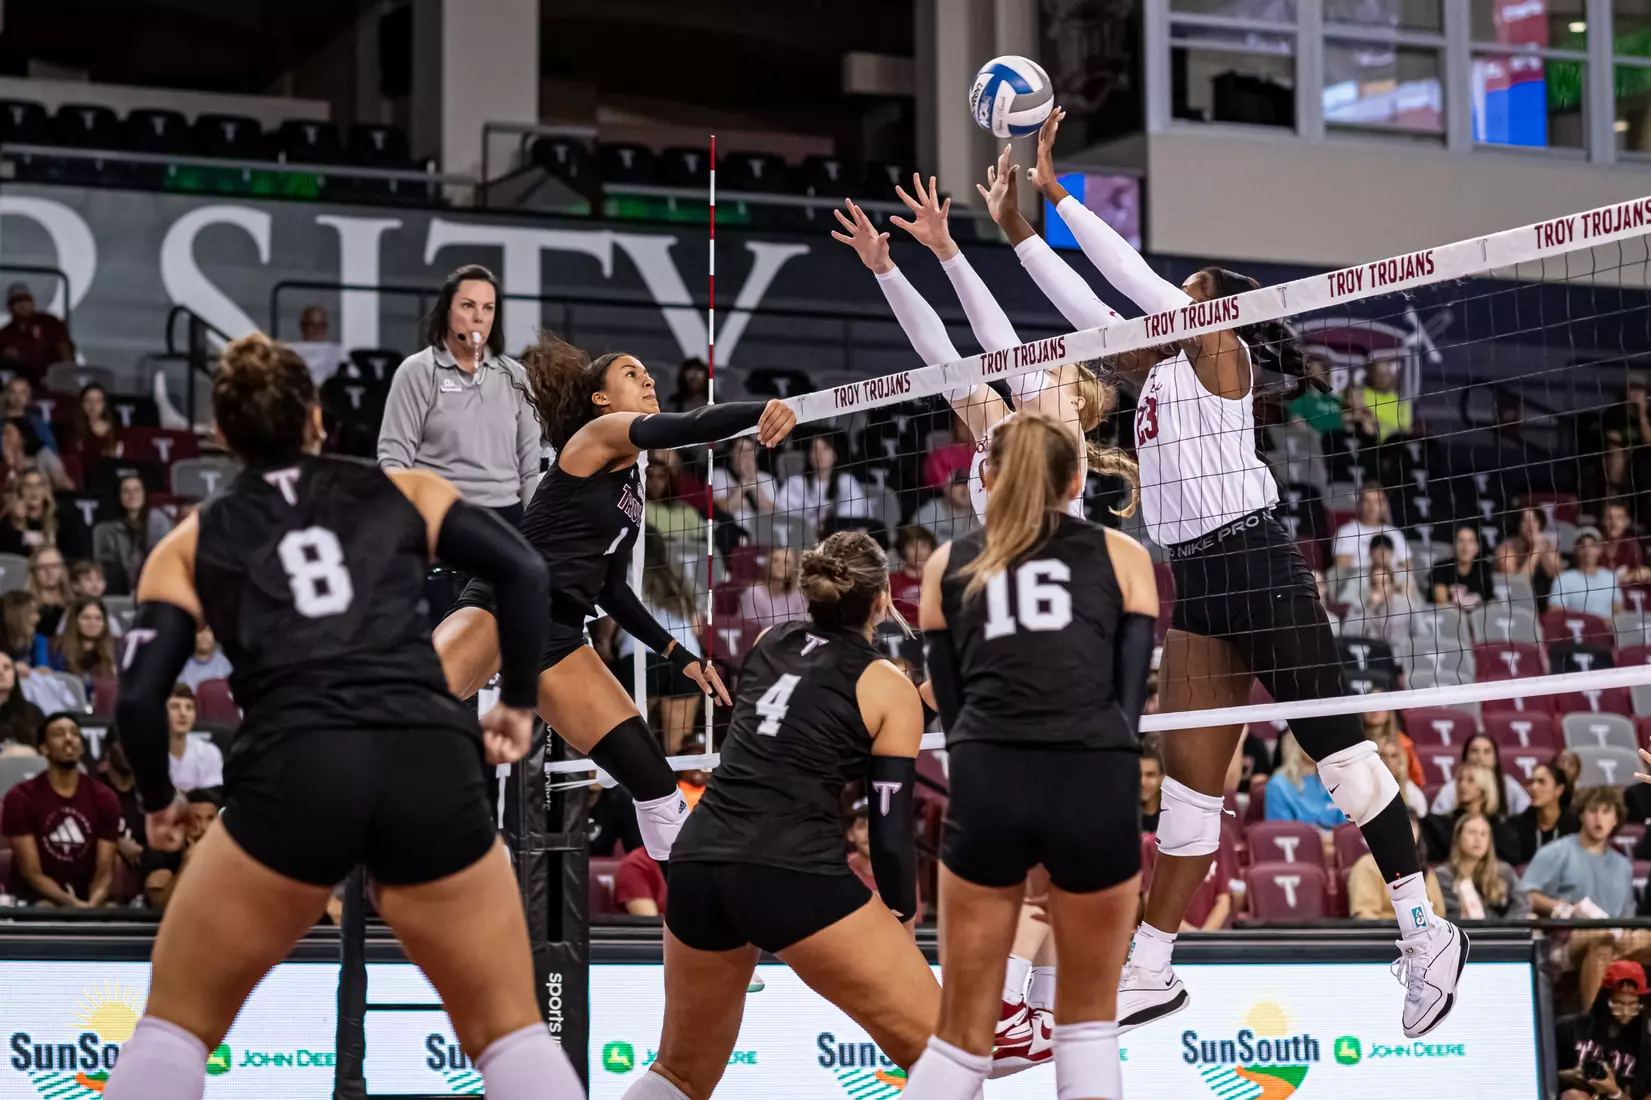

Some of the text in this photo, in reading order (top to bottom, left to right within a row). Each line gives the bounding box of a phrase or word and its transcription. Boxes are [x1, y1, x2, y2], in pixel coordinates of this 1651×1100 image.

[1534, 216, 1576, 249] TROY
[1327, 249, 1435, 298] TROY TROJANS
[1144, 296, 1239, 339] TROY TROJANS
[980, 336, 1066, 376] TROY TROJANS
[834, 371, 911, 409] TROY TROJANS
[1177, 515, 1260, 558] NIKE PRO
[277, 525, 355, 619] 8
[983, 557, 1074, 642] 16
[755, 673, 802, 738] 4
[545, 972, 565, 1033] sports
[238, 1049, 293, 1067] JOHN
[1181, 1028, 1321, 1066] SunSouth
[1367, 1041, 1467, 1059] JOHN DEERE
